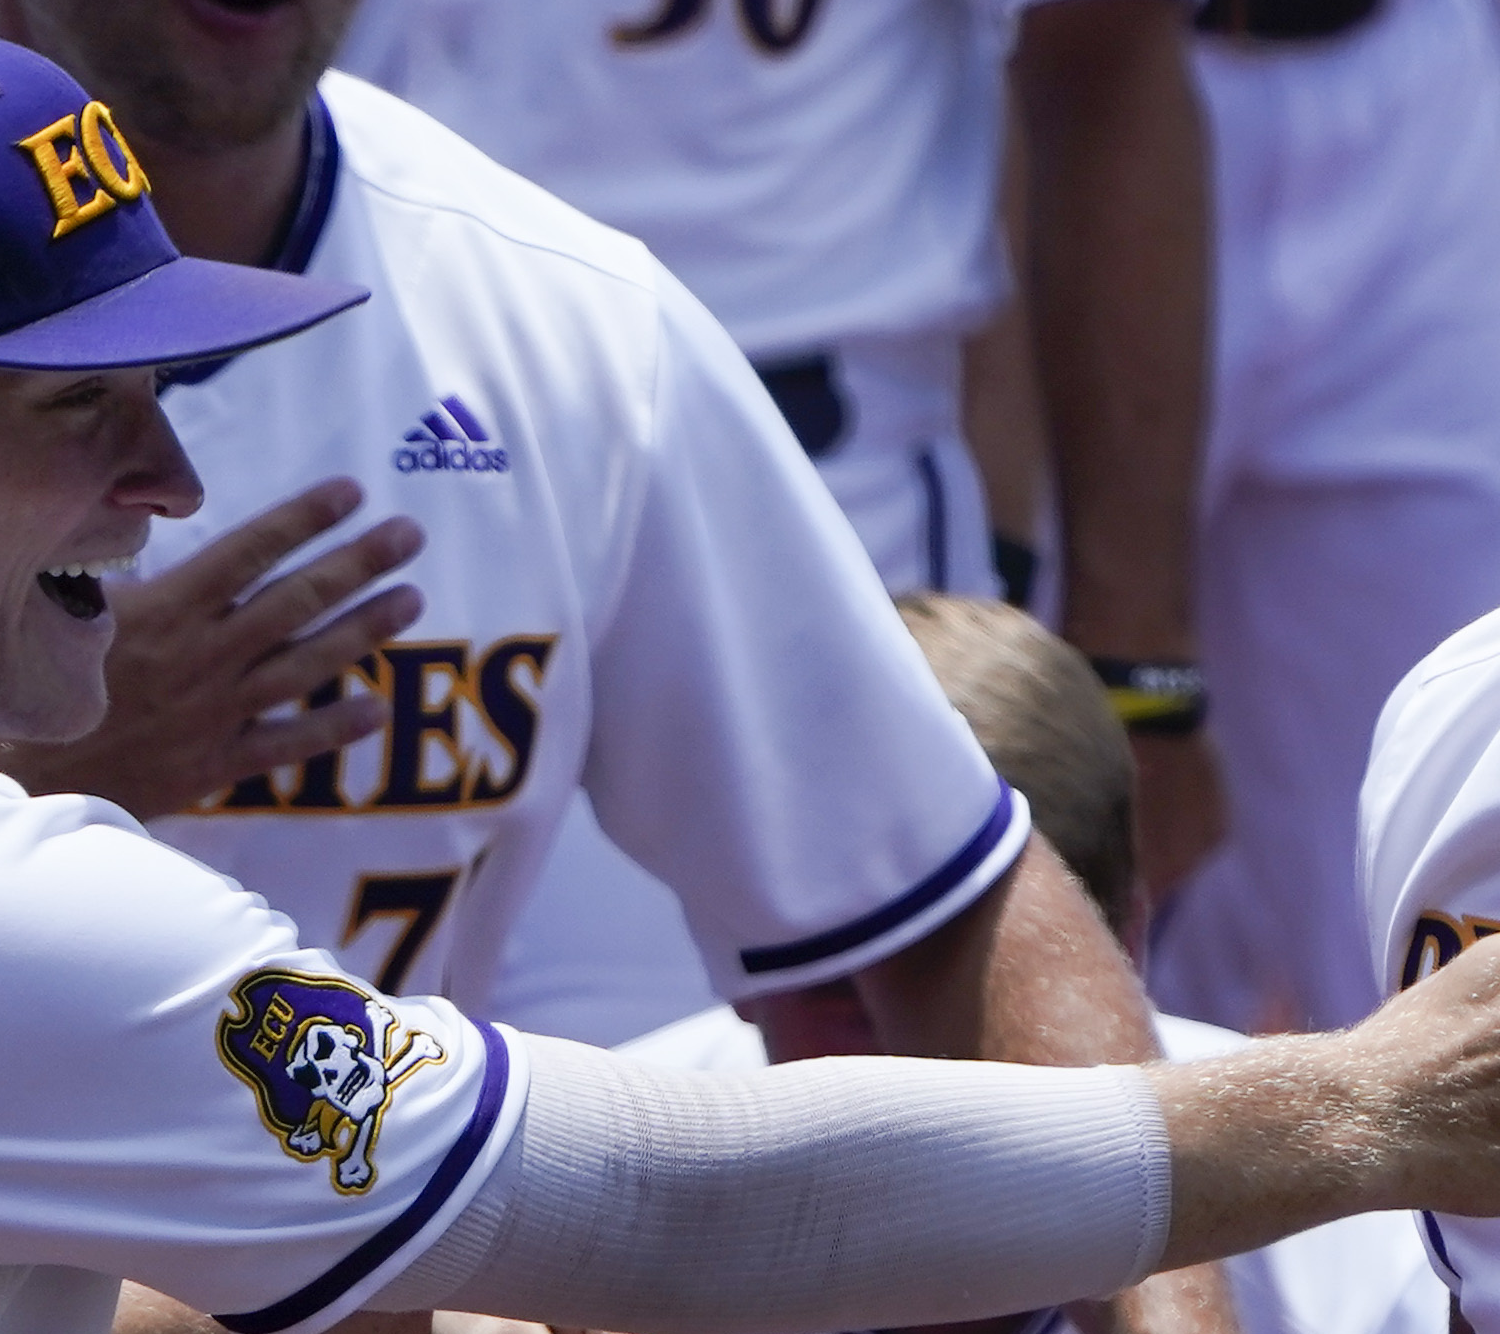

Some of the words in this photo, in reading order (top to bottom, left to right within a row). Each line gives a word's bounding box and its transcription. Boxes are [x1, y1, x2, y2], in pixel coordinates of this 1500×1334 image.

[12, 99, 152, 240] EC
[395, 439, 510, 472] adidas
[338, 870, 462, 997] 7
[249, 991, 295, 1064] ECU
